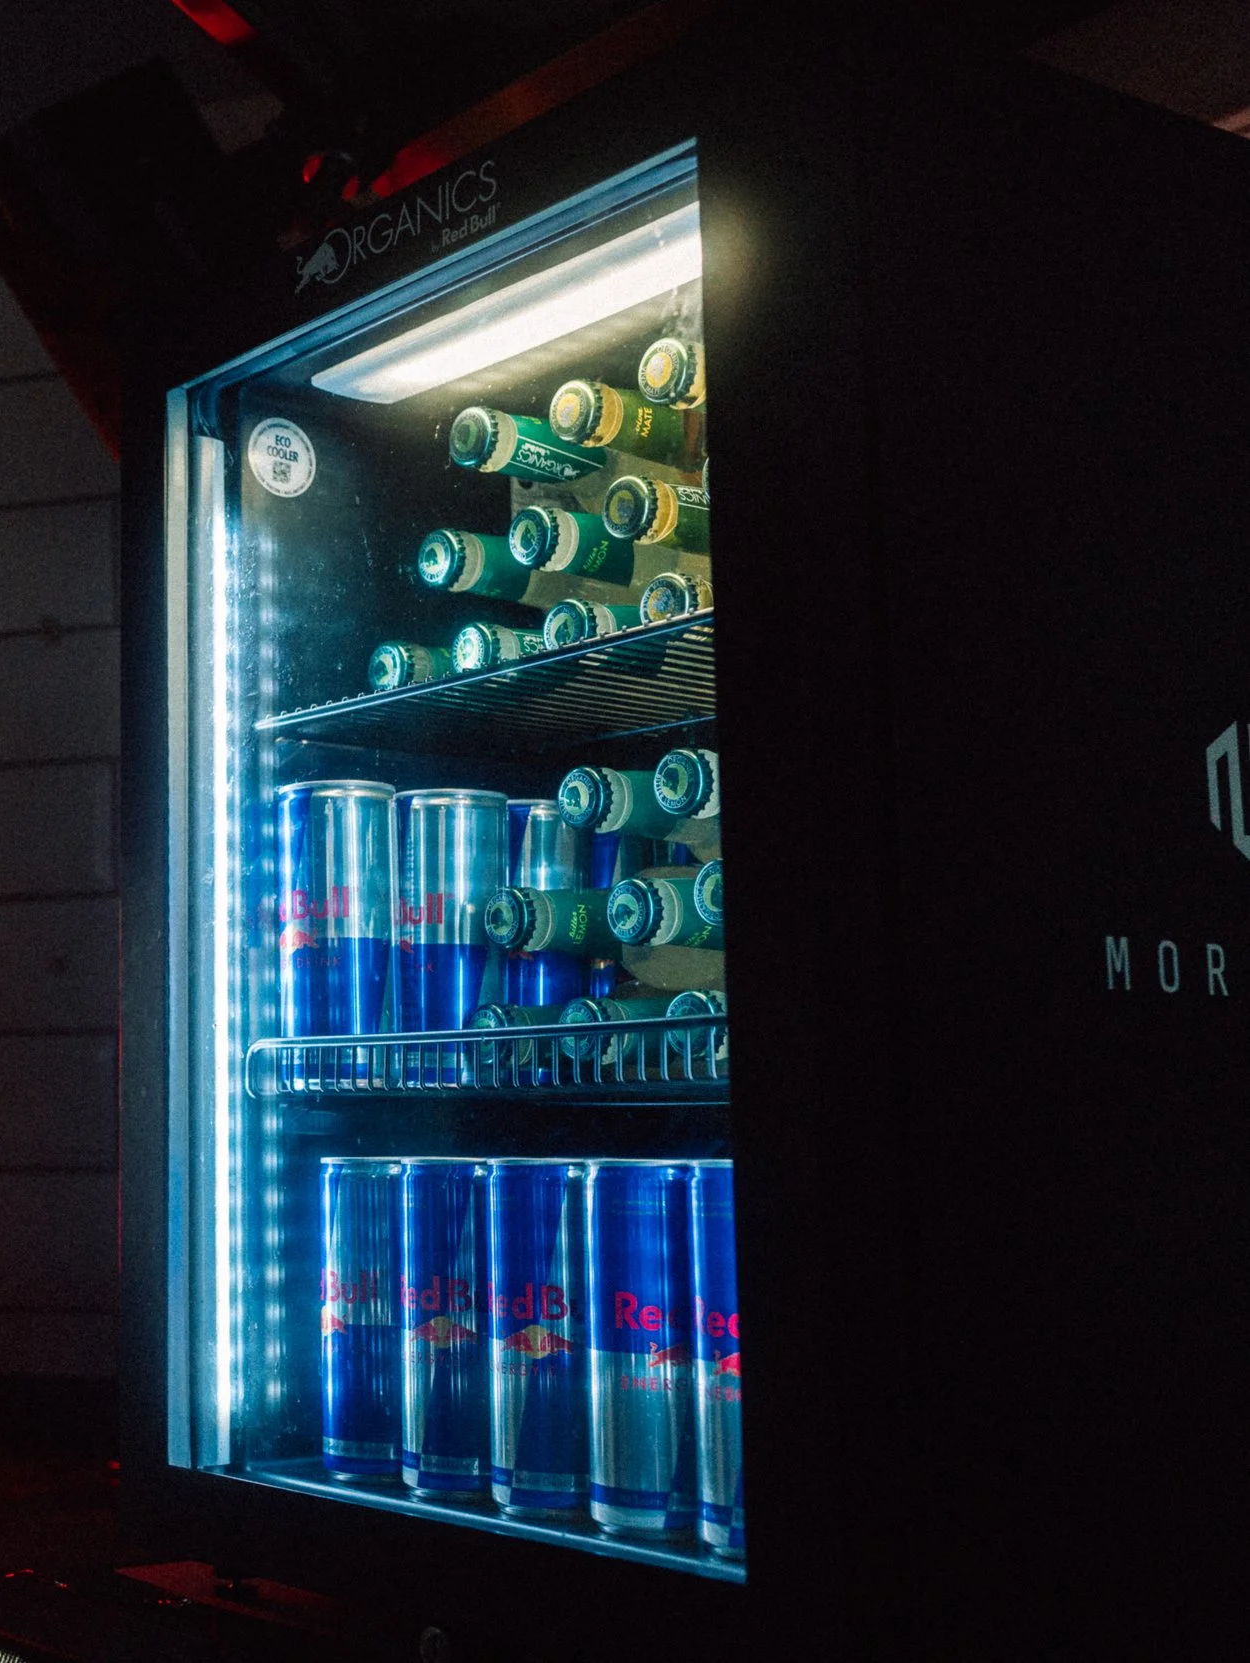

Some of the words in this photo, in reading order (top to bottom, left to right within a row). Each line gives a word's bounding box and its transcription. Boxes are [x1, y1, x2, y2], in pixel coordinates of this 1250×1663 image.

[317, 160, 497, 284] ORGANICS
[640, 407, 653, 438] MATE
[267, 445, 299, 463] COOLER
[275, 434, 292, 448] ECO
[292, 885, 350, 920] Bull
